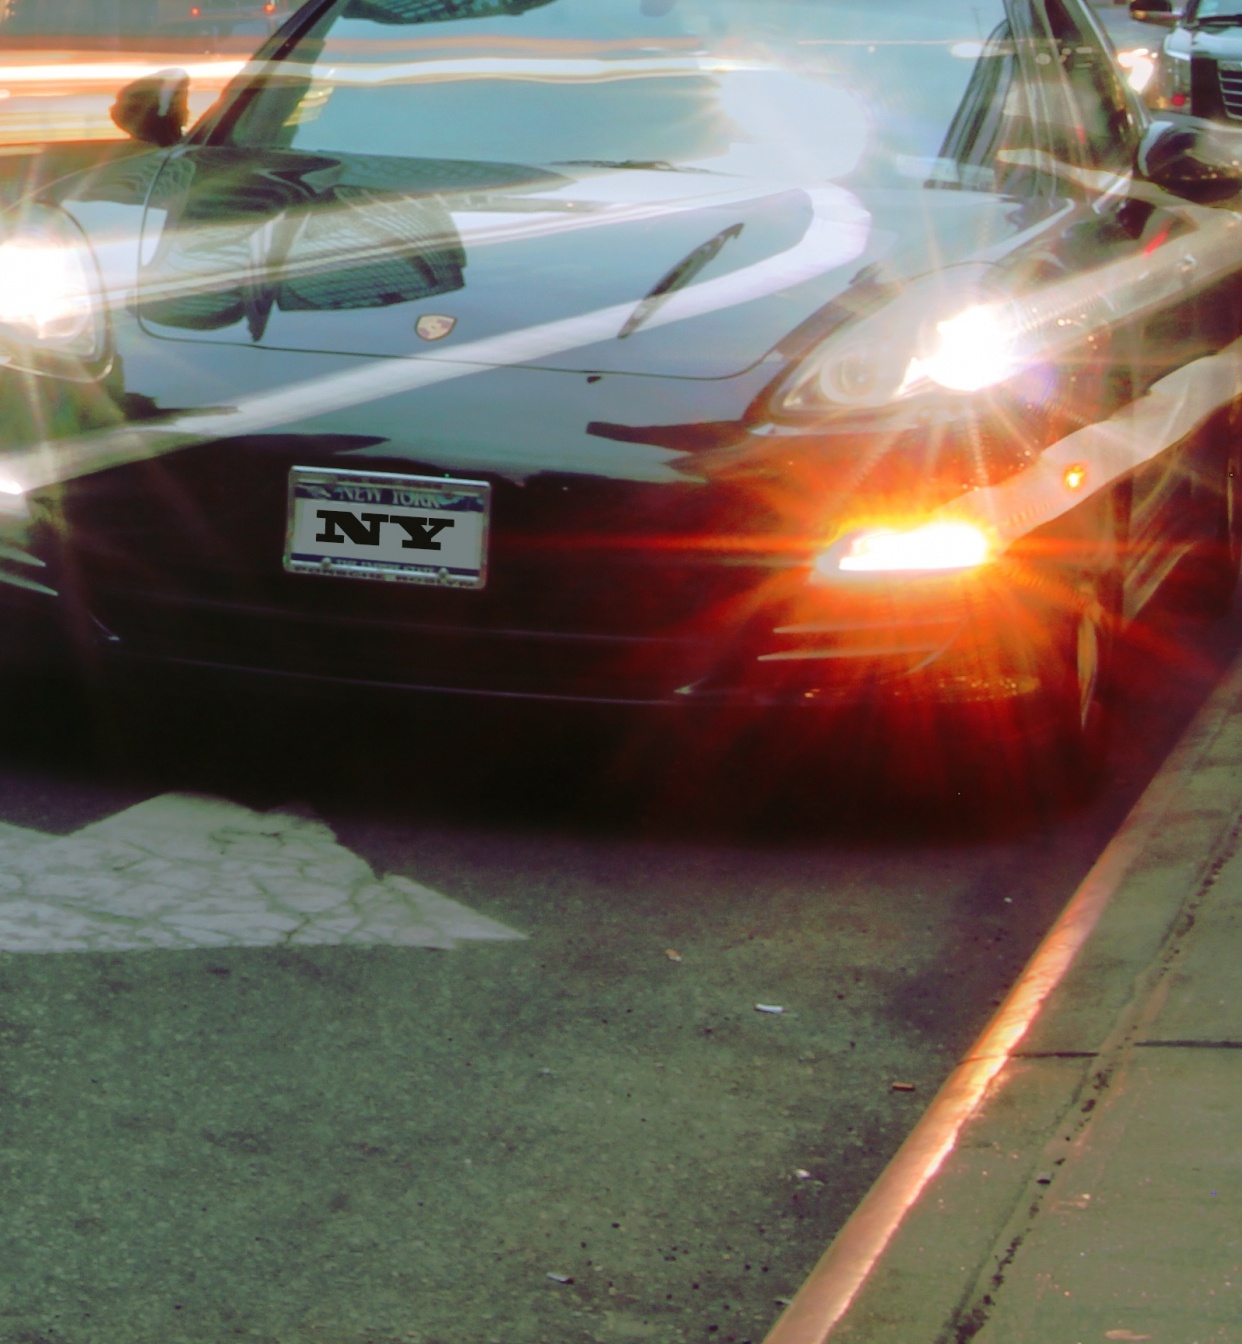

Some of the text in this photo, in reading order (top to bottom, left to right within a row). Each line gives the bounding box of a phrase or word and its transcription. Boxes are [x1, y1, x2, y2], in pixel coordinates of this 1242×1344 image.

[340, 487, 441, 508] NEW YORK
[316, 510, 455, 551] NY
